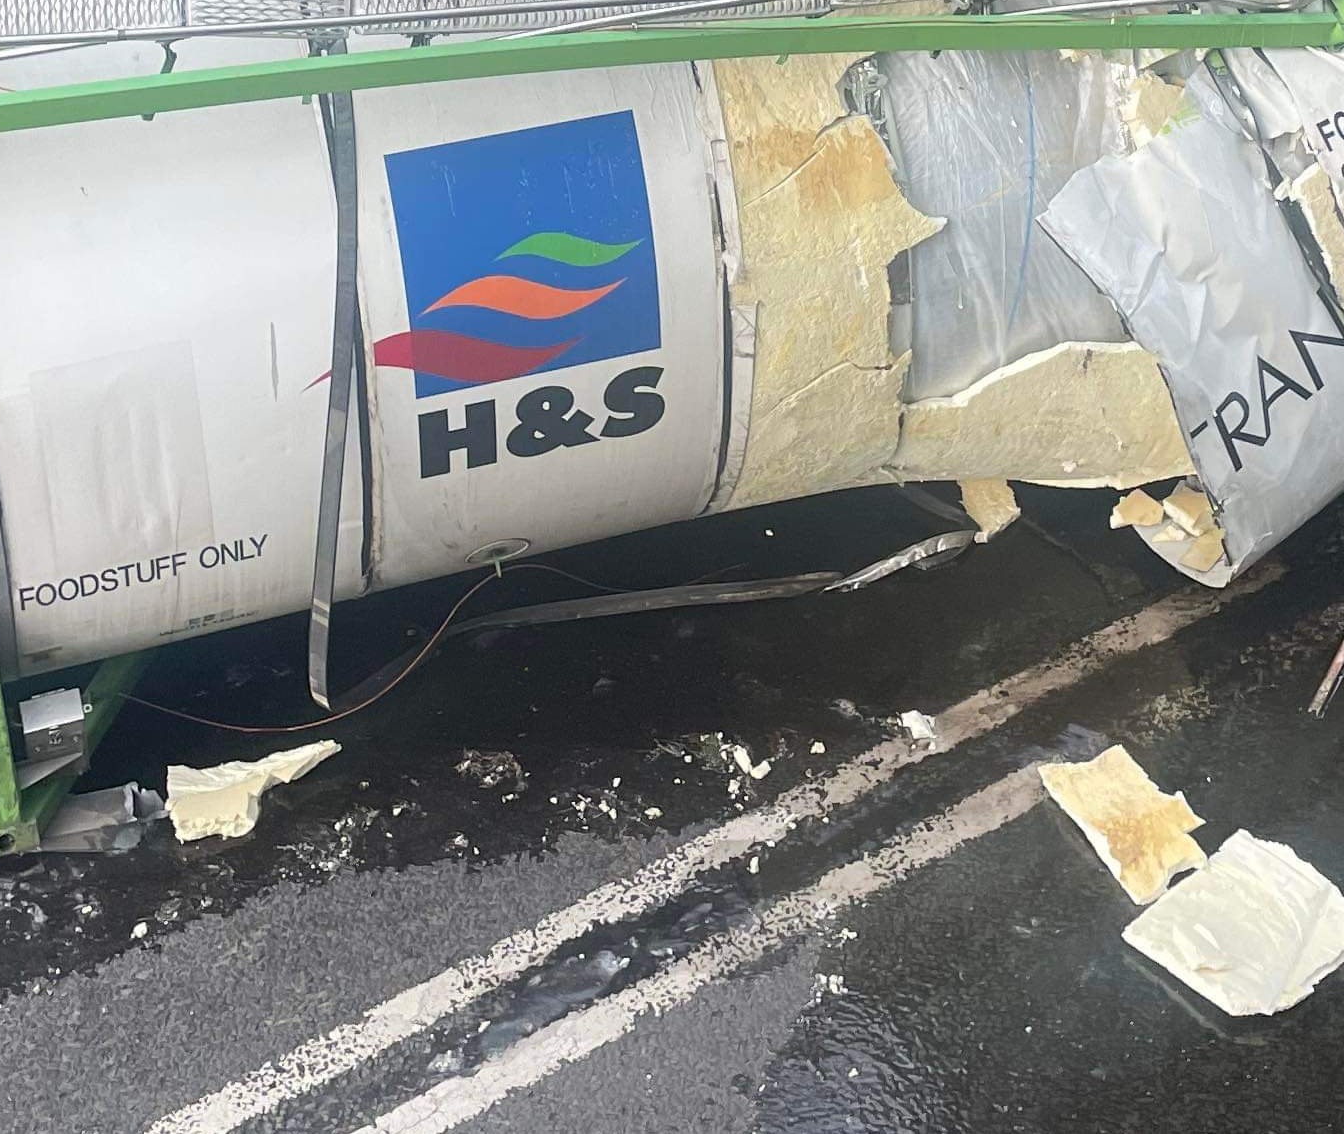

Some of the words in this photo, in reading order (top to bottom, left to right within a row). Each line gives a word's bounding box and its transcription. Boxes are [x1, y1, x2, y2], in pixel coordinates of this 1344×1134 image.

[418, 366, 665, 479] H&S
[18, 552, 188, 611] FOODSTUFF
[199, 533, 268, 569] ONLY
